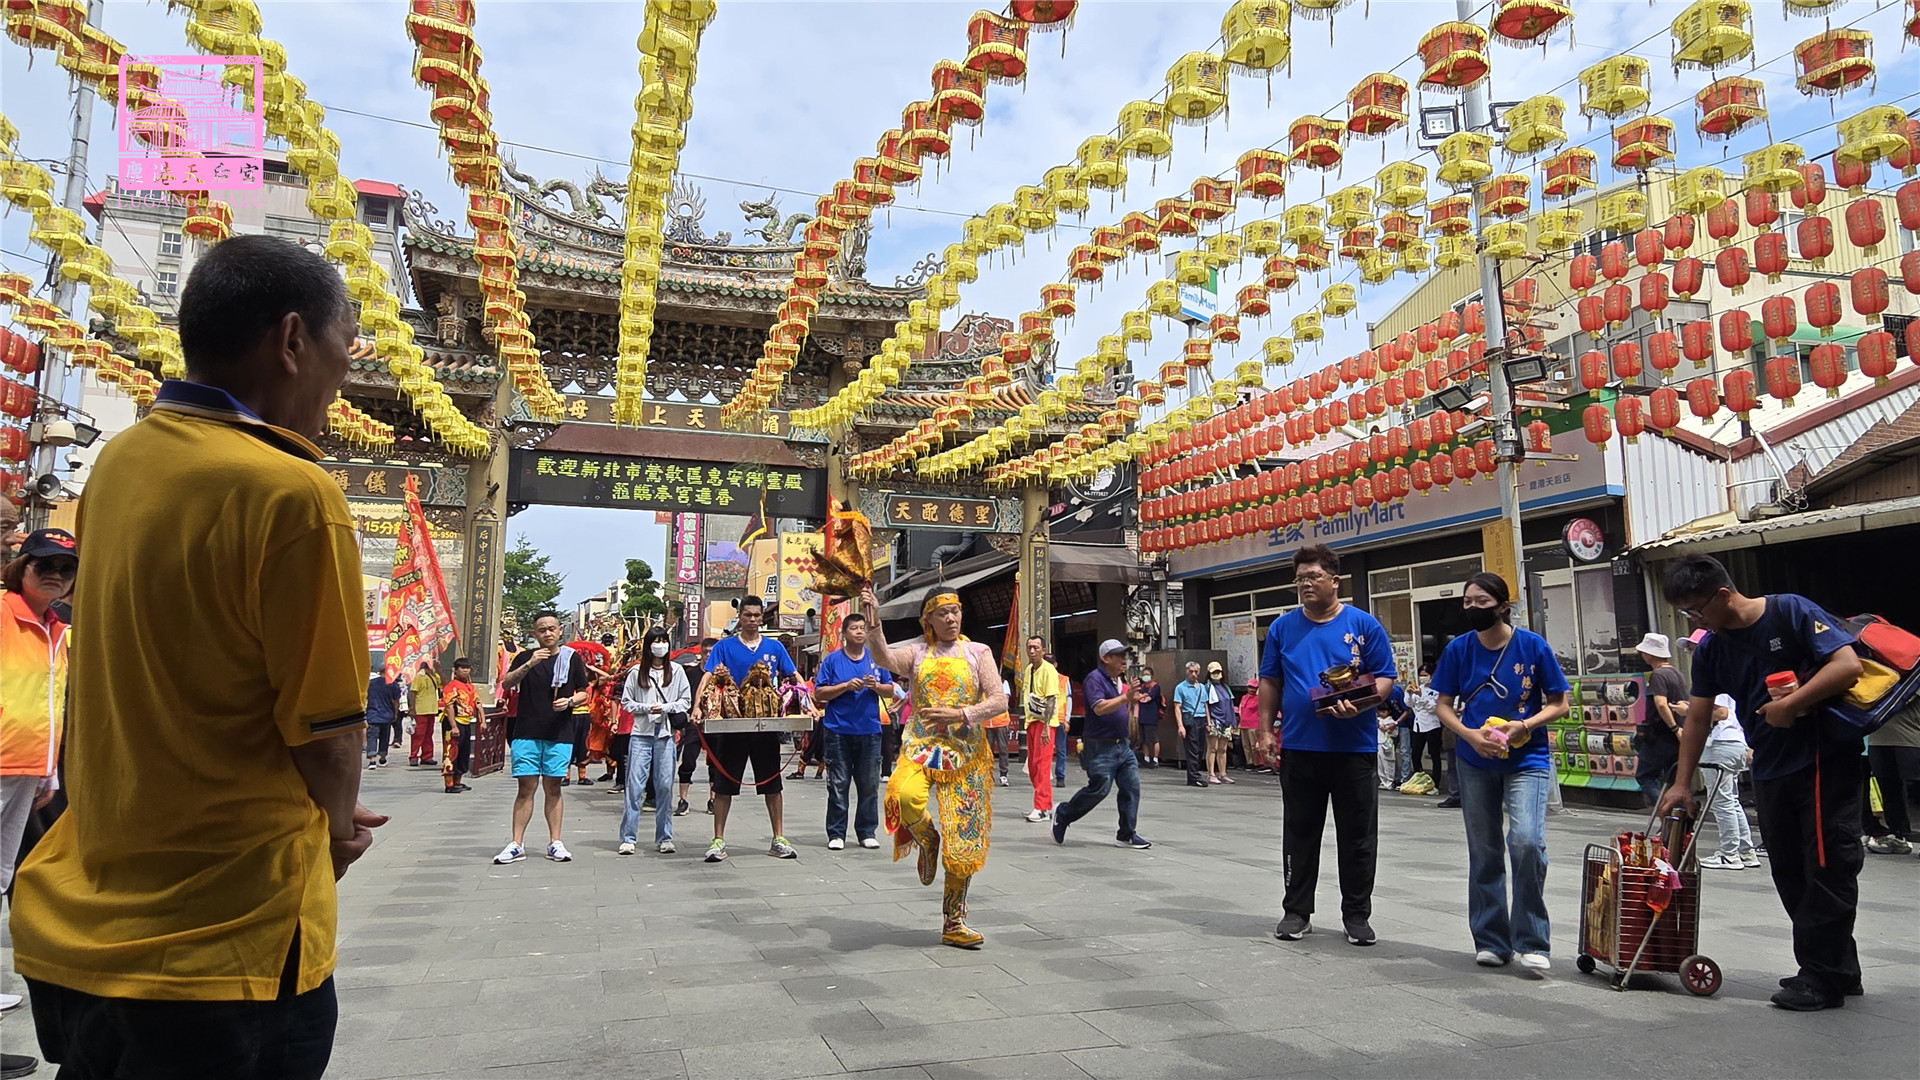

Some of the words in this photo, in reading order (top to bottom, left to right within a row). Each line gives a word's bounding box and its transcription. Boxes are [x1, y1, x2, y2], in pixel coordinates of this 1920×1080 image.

[894, 501, 991, 525] 聖德配天
[1313, 501, 1405, 538] FamilyMart
